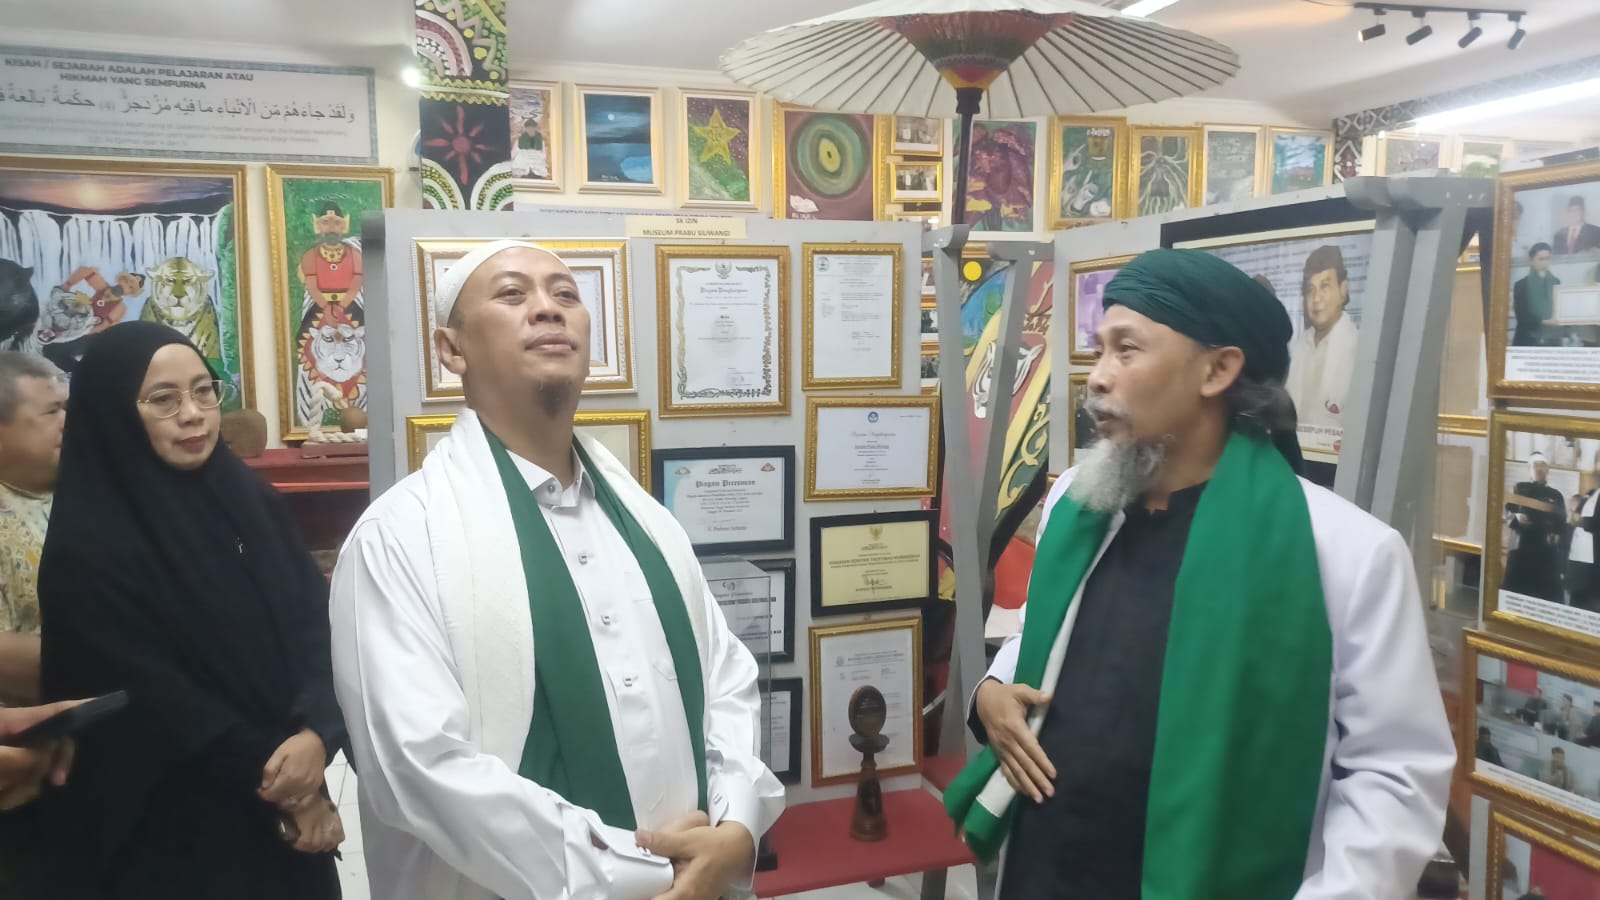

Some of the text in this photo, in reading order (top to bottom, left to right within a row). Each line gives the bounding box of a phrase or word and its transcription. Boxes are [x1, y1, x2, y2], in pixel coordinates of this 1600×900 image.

[5, 59, 41, 68] KISAH
[52, 61, 104, 72] SEJARAH
[108, 65, 156, 76] ADALAH
[159, 68, 223, 80] PELAJARAN
[226, 73, 254, 81] ATAU
[60, 73, 206, 89] HIKMAH YANG SEMPURNA
